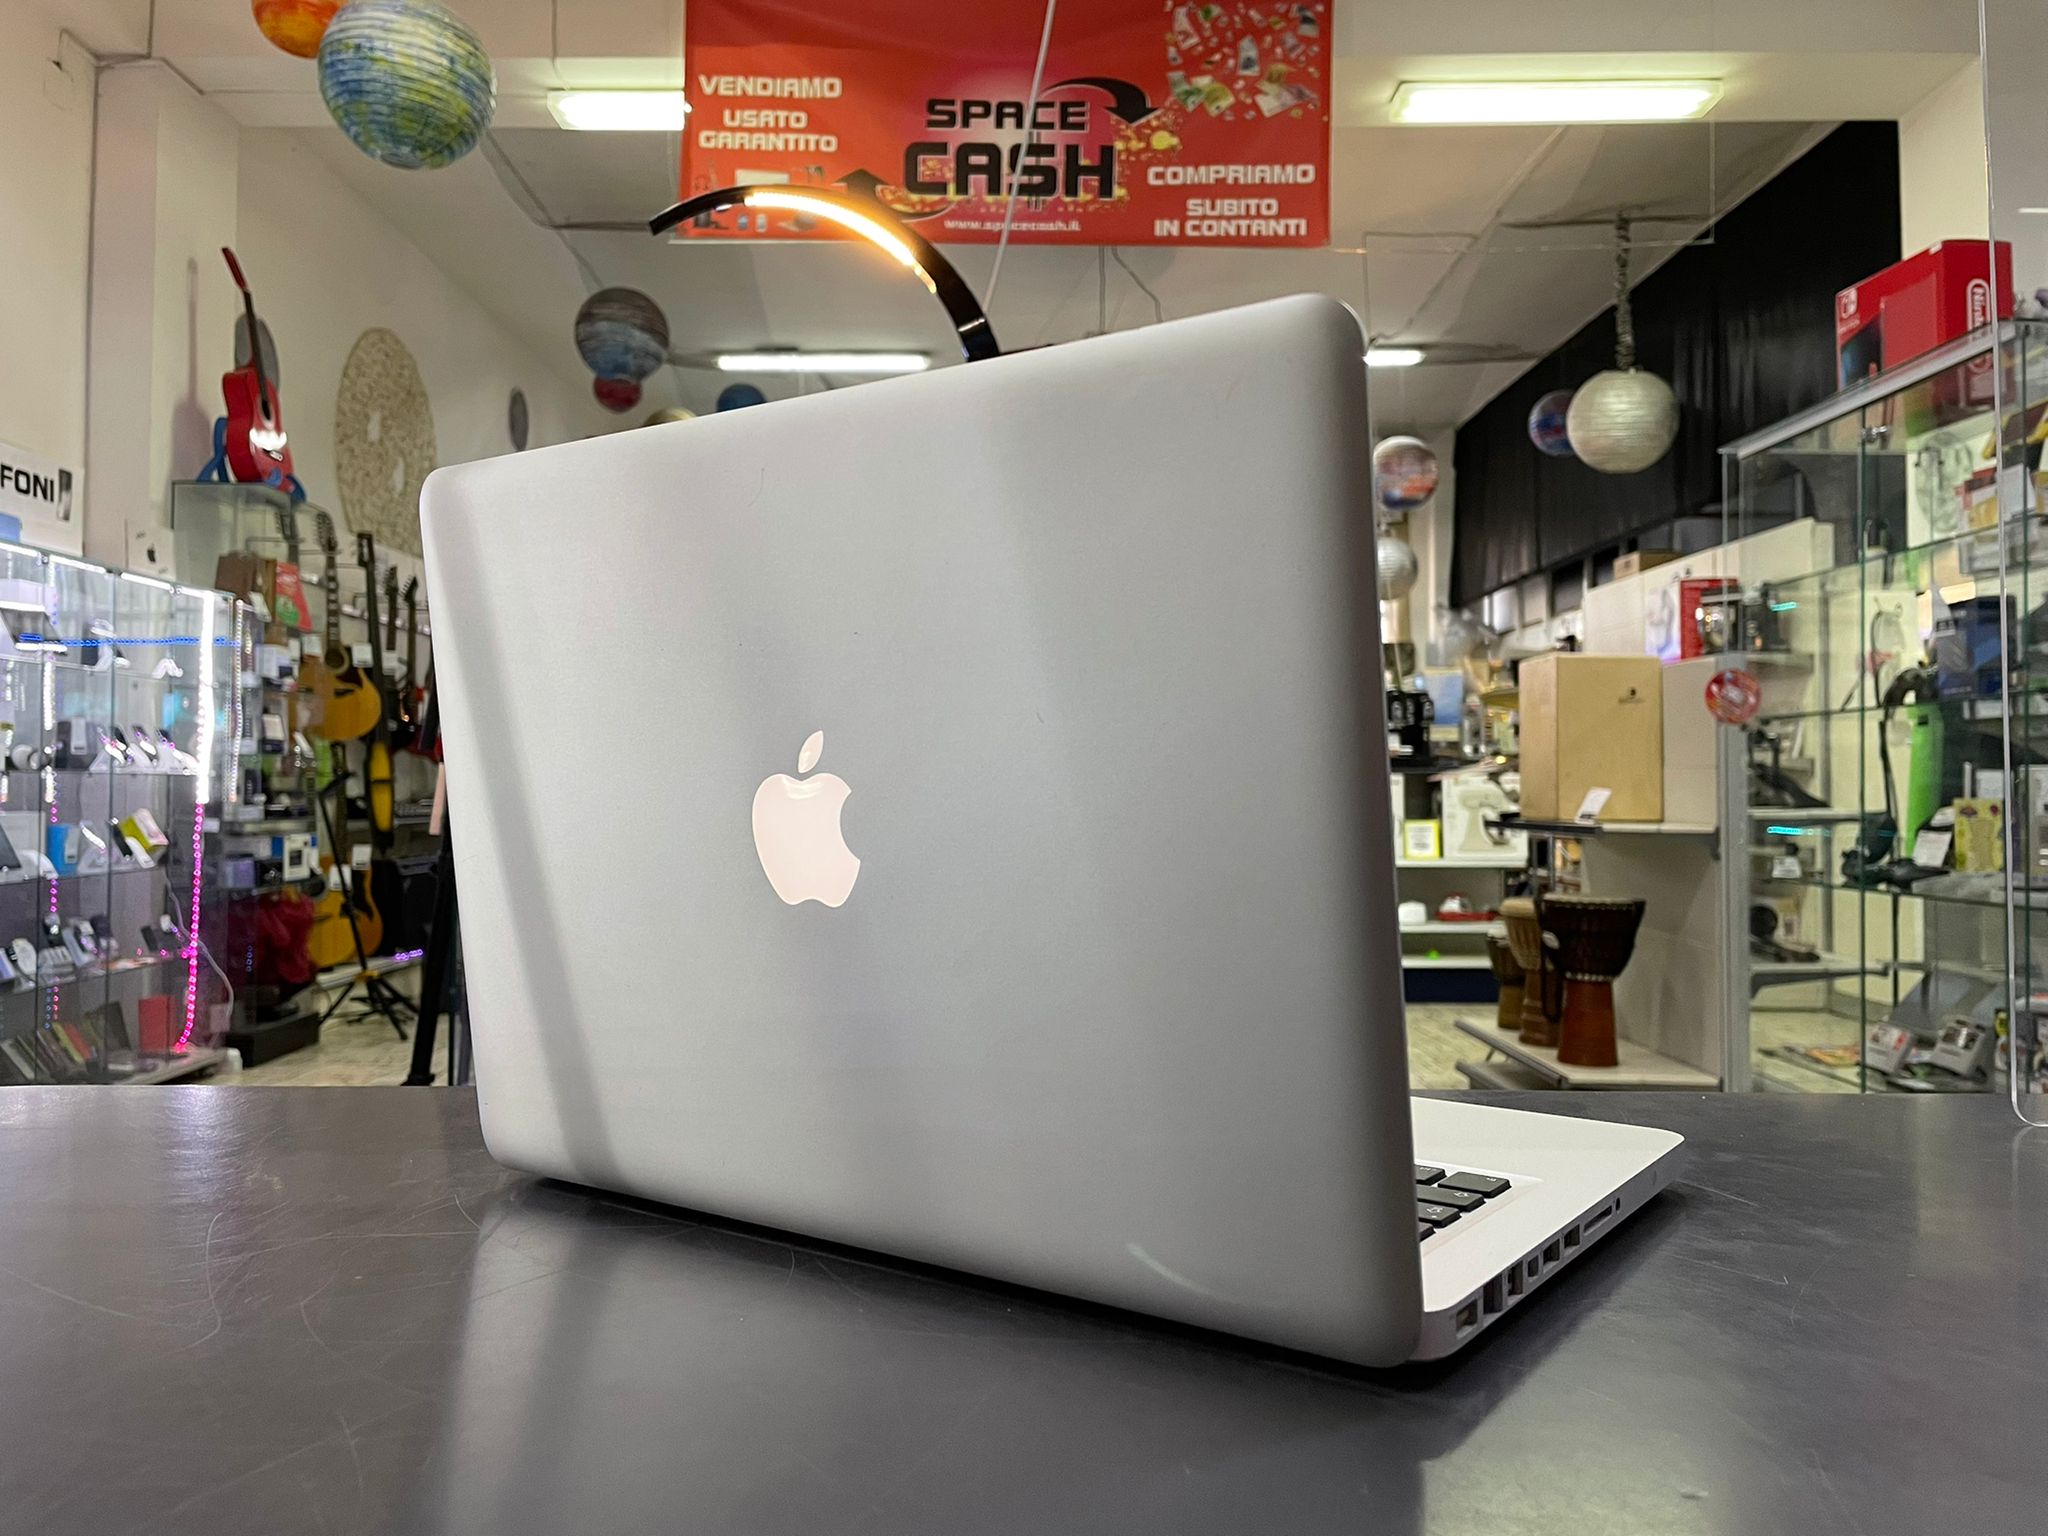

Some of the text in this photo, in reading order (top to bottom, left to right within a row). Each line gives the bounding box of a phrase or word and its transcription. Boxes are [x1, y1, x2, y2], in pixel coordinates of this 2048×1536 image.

[699, 74, 842, 98] VENDIAMO
[723, 109, 808, 129] USATO
[926, 98, 1087, 131] SPACE
[698, 130, 838, 153] GARANTITO
[905, 141, 1114, 199] CASH
[1147, 164, 1316, 186] COMPRIAMO
[1186, 198, 1279, 216] SUBITO
[1154, 218, 1307, 237] IN CONTANTI
